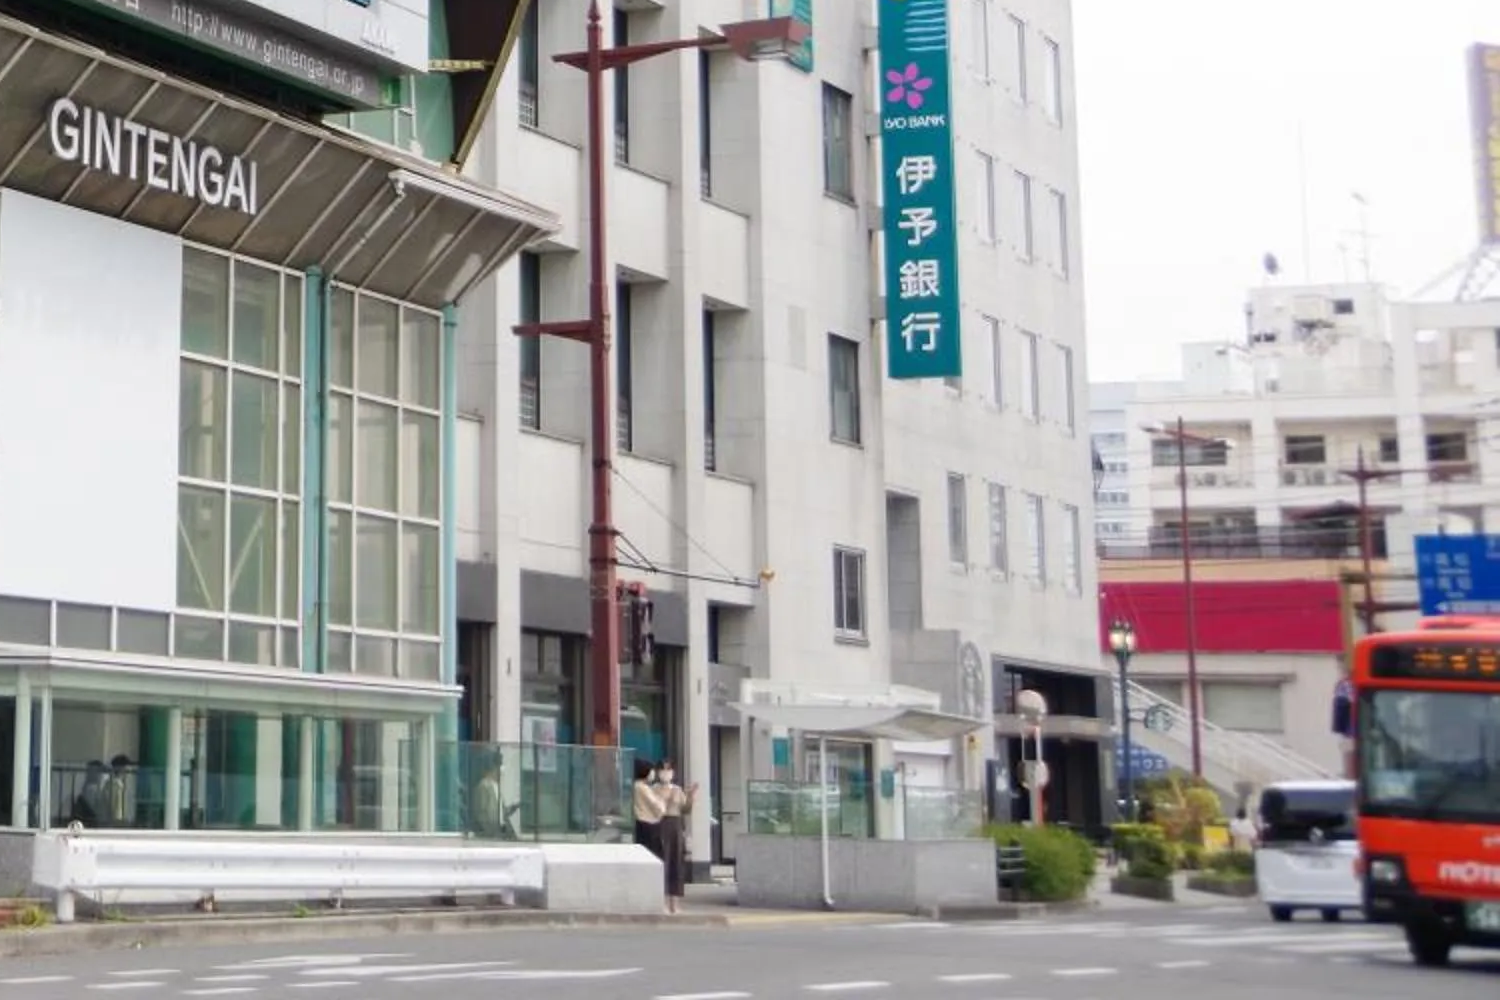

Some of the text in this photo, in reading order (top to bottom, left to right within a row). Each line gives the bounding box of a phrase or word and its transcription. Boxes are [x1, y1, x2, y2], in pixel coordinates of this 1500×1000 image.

[50, 97, 258, 216] GINTENGAI
[908, 114, 945, 128] BANK
[896, 154, 941, 353] 伊予銀行
